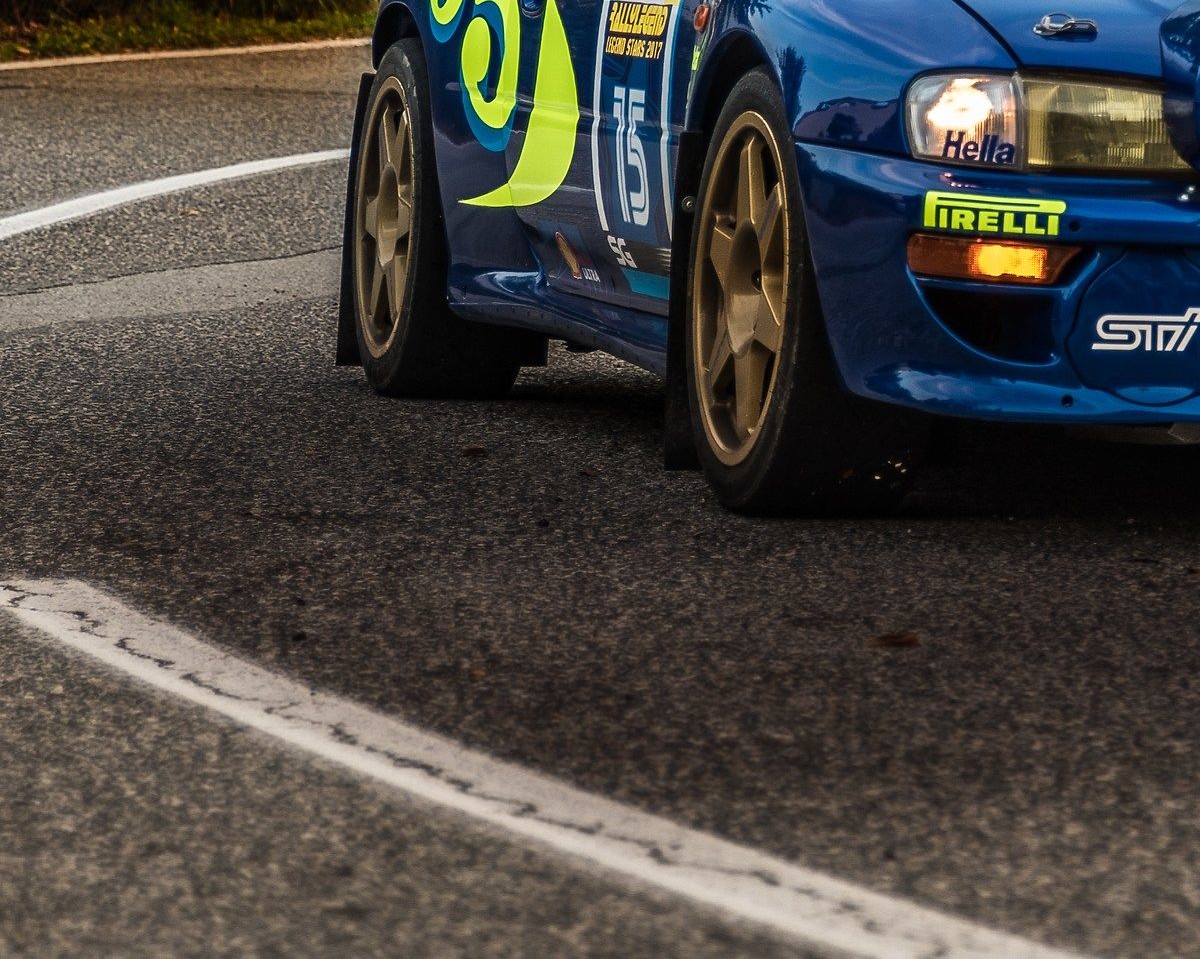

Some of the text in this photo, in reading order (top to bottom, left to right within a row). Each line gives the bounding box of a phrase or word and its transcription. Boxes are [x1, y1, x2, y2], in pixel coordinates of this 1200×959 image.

[626, 38, 646, 58] STARS
[645, 40, 663, 59] 2017
[613, 86, 650, 226] 15
[942, 130, 1016, 164] Hella
[923, 191, 1067, 236] PIRELLI
